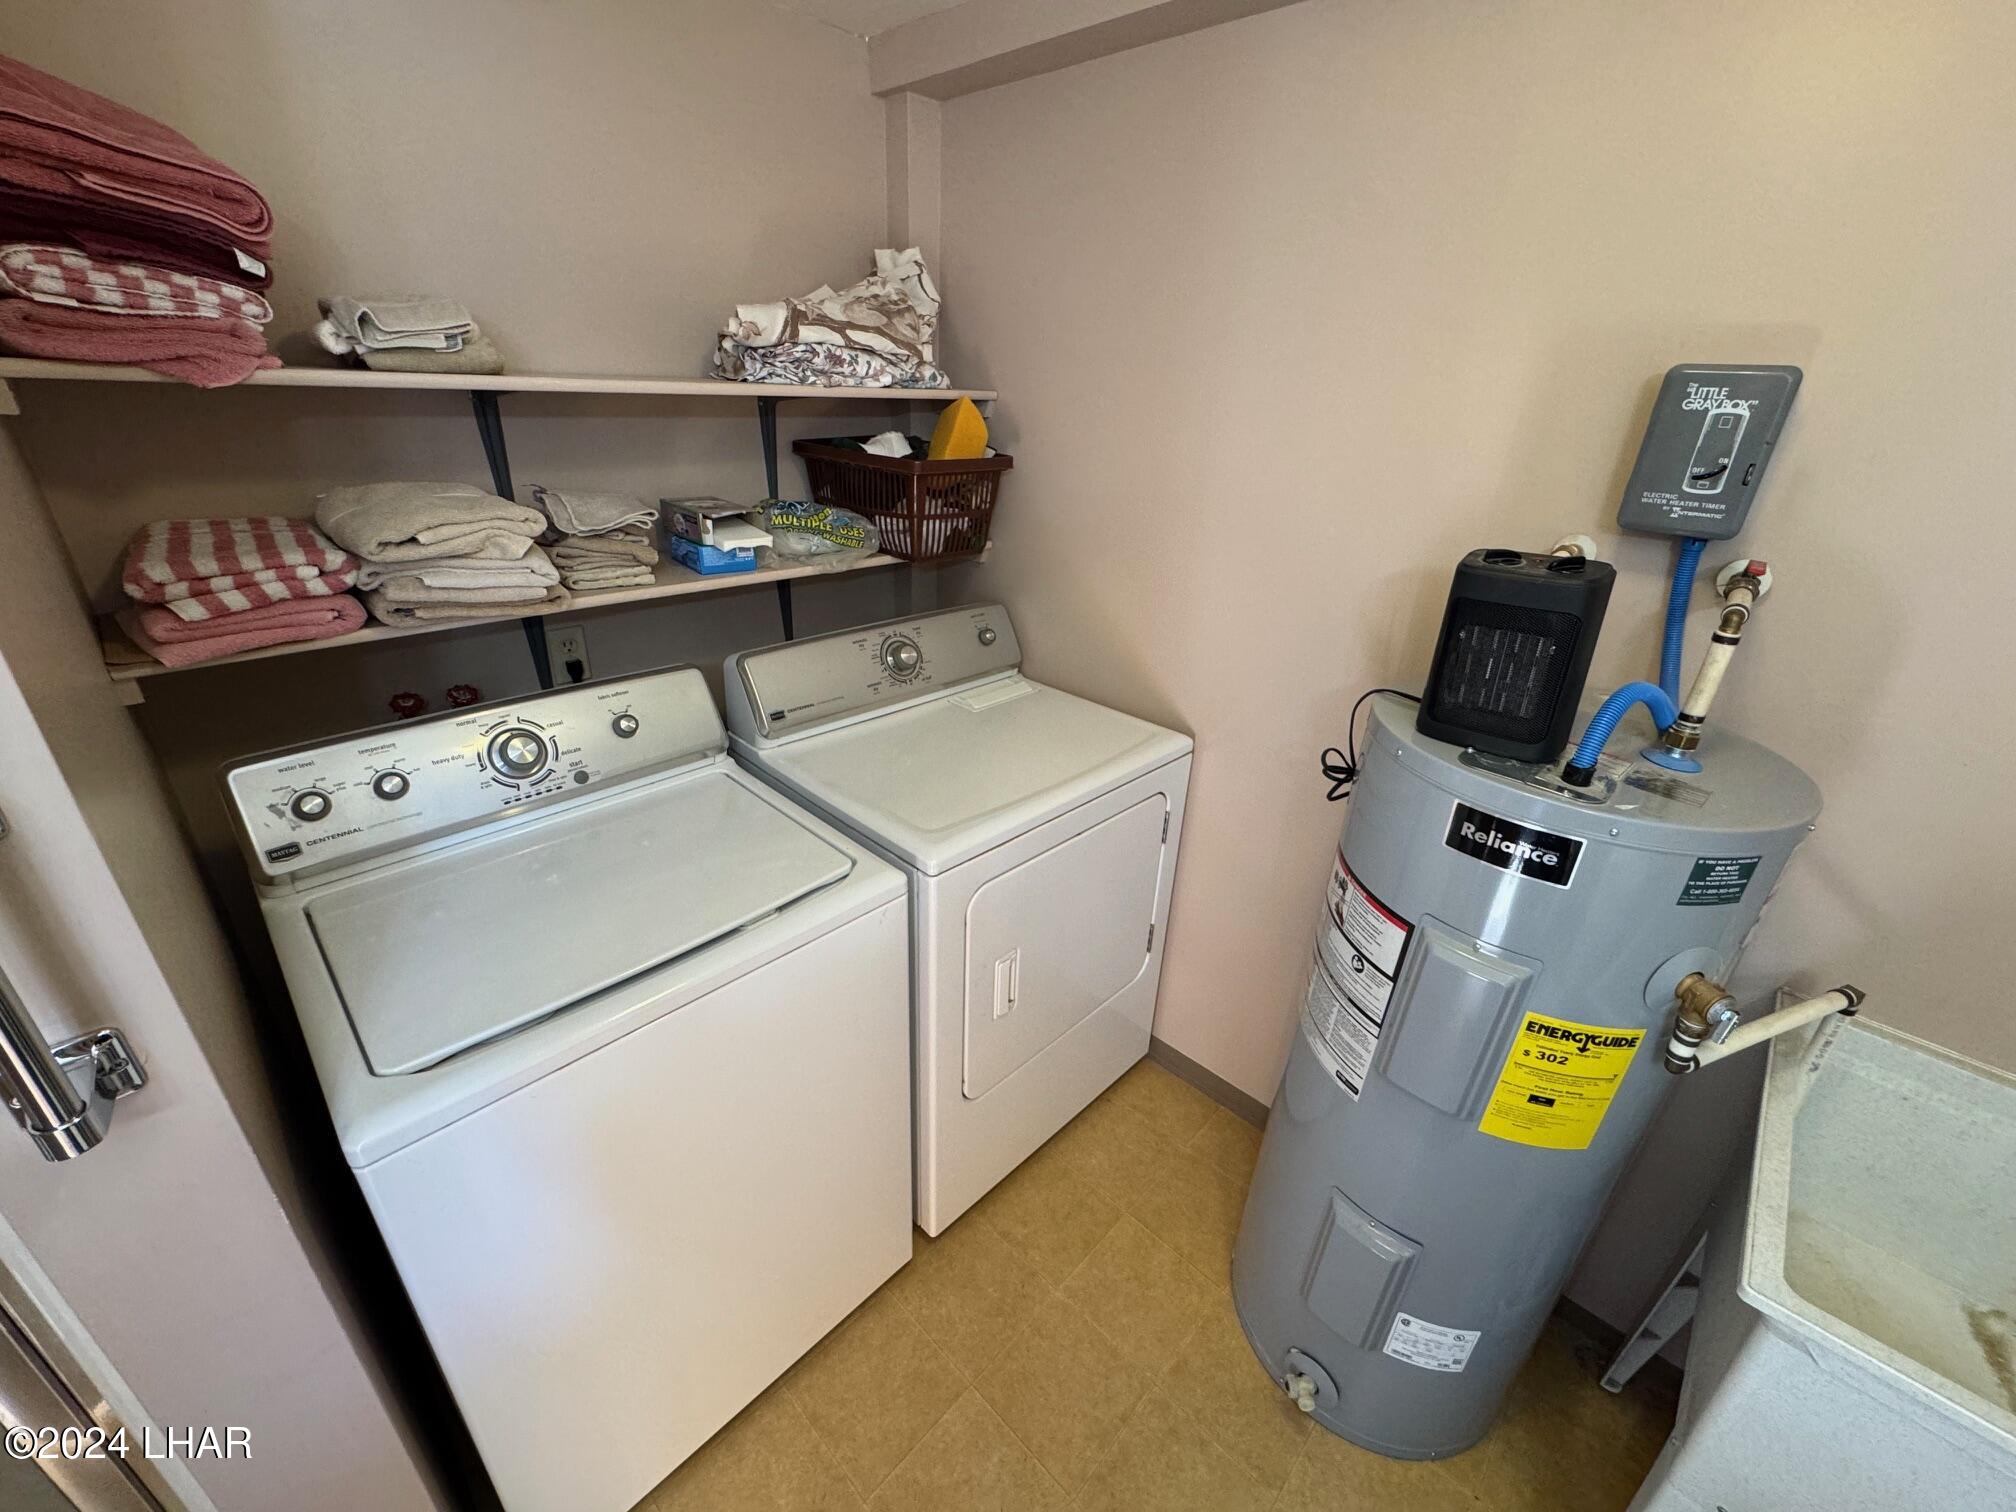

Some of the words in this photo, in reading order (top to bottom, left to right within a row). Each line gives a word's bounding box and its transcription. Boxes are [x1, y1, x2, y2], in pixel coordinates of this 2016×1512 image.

[1682, 399, 1721, 410] GRAY
[1642, 491, 1679, 500] ELECTRIC
[1701, 502, 1726, 511] TIMER
[771, 514, 832, 531] MULTIPLE
[840, 526, 865, 538] USES
[456, 718, 477, 727] normal
[546, 719, 564, 729] casual
[357, 742, 396, 756] temperature
[561, 746, 582, 757] delicate
[431, 756, 451, 766] heavy
[451, 753, 465, 762] duty
[568, 759, 583, 768] start
[277, 764, 297, 774] water
[298, 760, 315, 770] level
[270, 845, 300, 859] MAYTAG
[306, 826, 364, 847] CENTENNIAL
[1460, 821, 1558, 866] Reliance
[1536, 1050, 1569, 1066] 302
